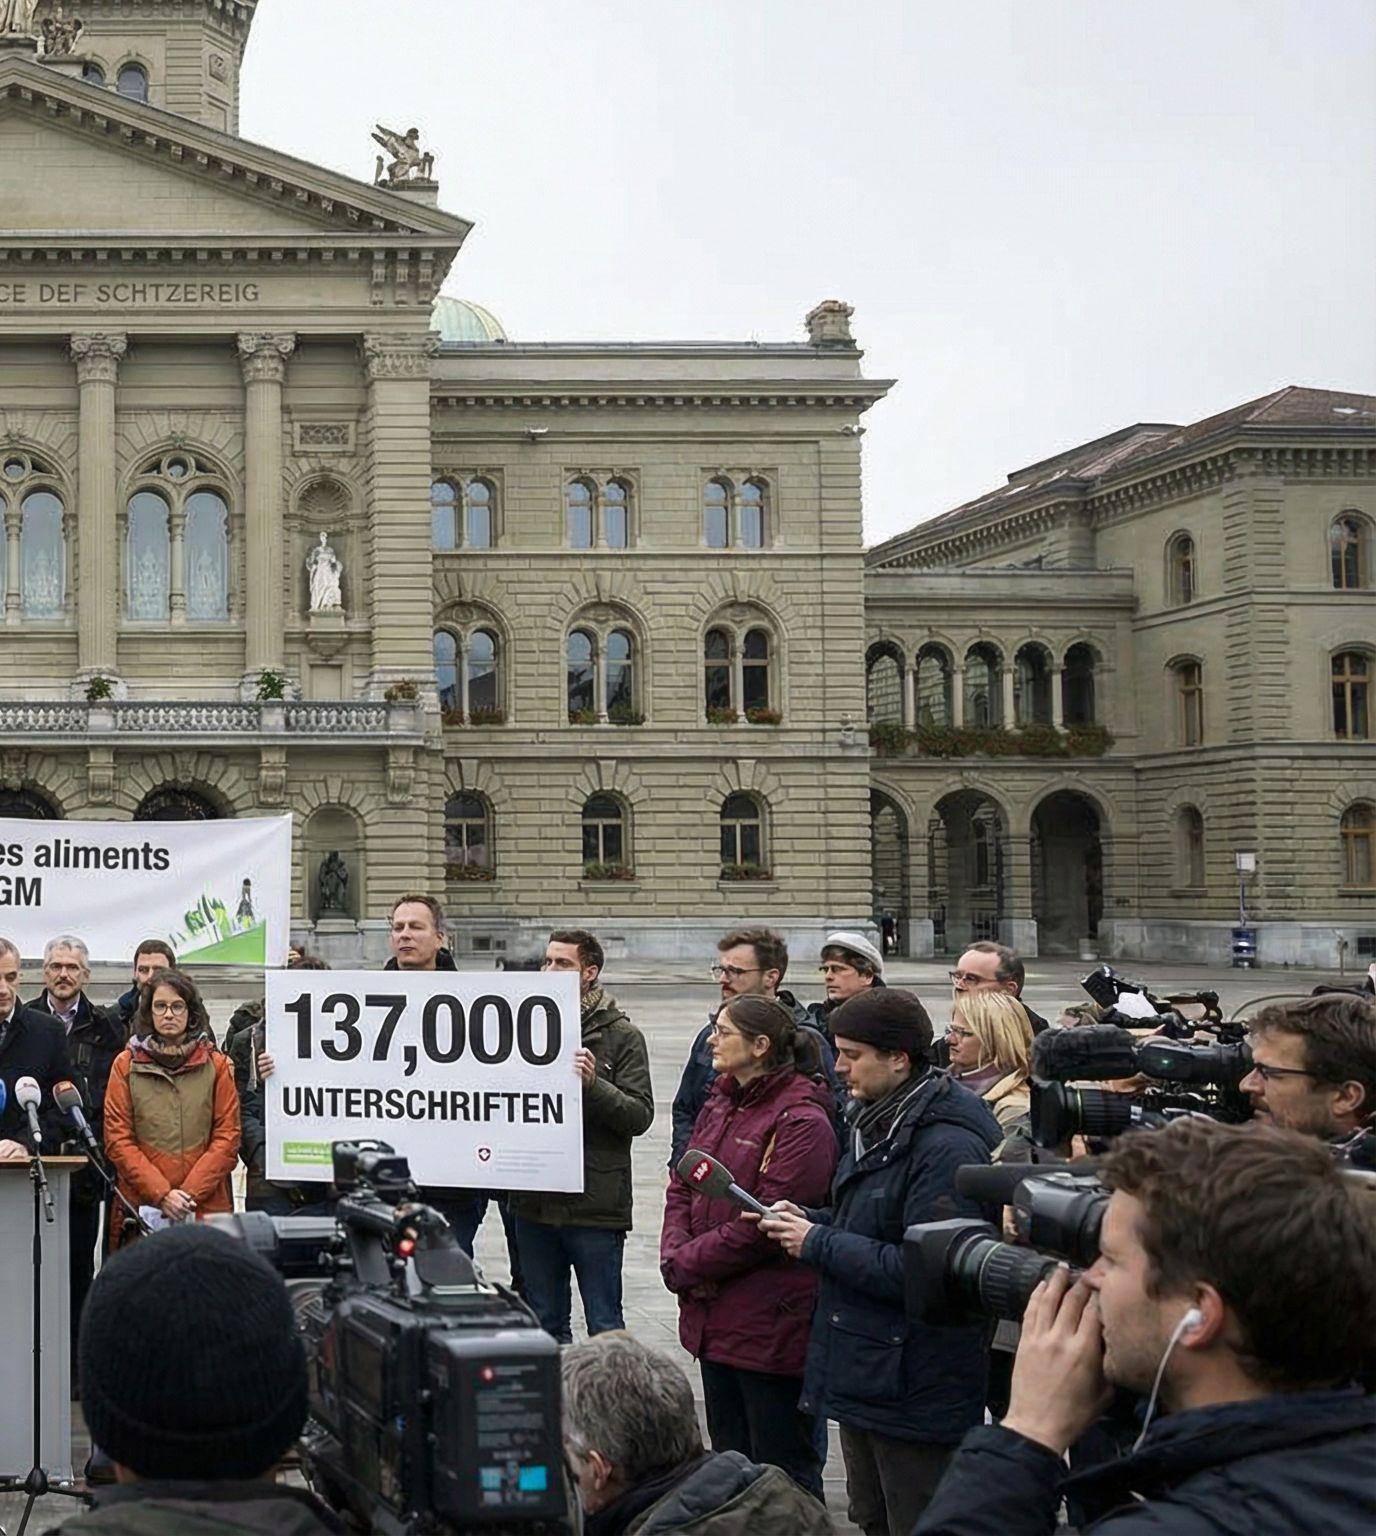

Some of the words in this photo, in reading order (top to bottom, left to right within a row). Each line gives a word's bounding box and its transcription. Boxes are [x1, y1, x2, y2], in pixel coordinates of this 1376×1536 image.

[96, 284, 259, 303] SCHTZEREIG
[33, 838, 170, 871] aliments
[284, 993, 562, 1076] 137,000
[283, 1086, 564, 1124] UNTERSCHRIFTEN
